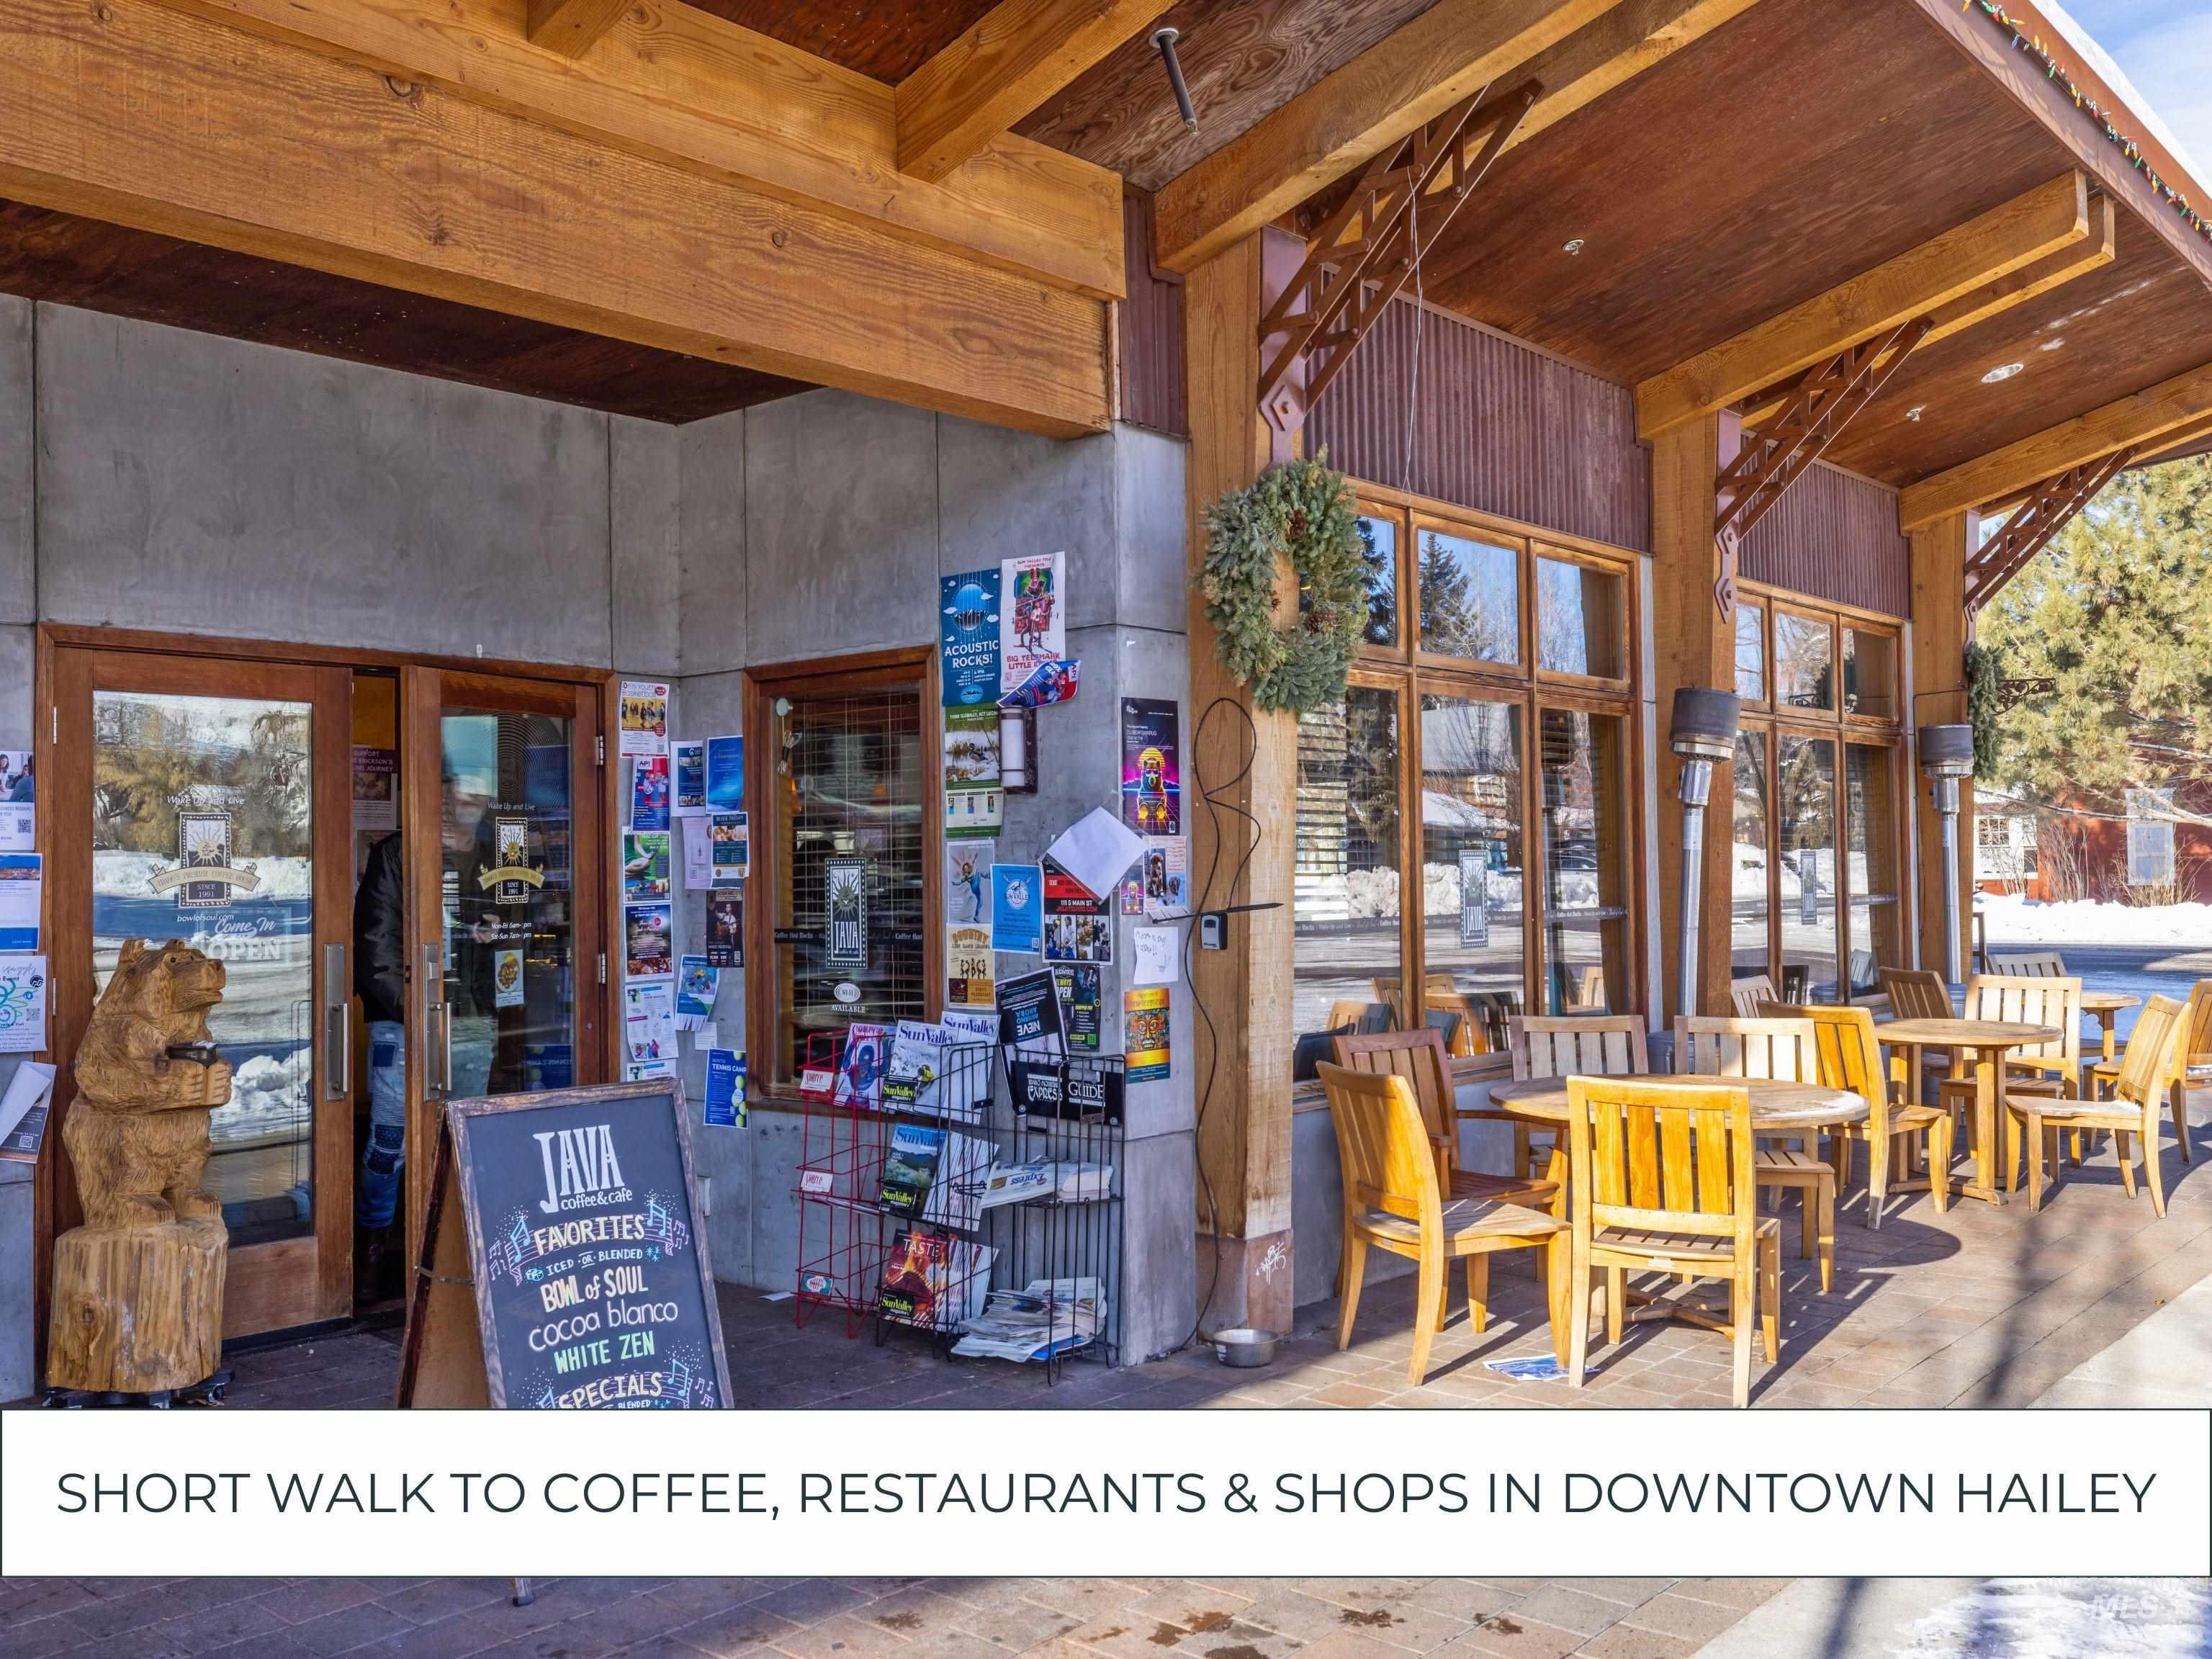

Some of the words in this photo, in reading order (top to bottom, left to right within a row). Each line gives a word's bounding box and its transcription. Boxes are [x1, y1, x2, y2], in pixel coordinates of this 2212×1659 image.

[944, 639, 999, 657] ACOUSTIC
[952, 653, 993, 668] ROCKS!
[167, 795, 191, 805] Wake
[228, 796, 246, 805] Live
[487, 800, 503, 810] Wake
[177, 914, 234, 922] bowlofsoul.com
[215, 919, 257, 936] Come
[256, 917, 276, 932] In
[491, 921, 508, 930] Mon-Fri
[1465, 905, 1483, 936] JAVA
[834, 921, 859, 955] JAVA
[207, 940, 281, 961] OPEN
[831, 1004, 866, 1014] AVAILABLE
[1016, 1020, 1041, 1037] NIEVE
[1027, 1085, 1064, 1102] EXPRESS
[1068, 1082, 1105, 1099] GUIDE
[533, 1124, 626, 1214] JAVA
[1010, 1172, 1045, 1186] Express
[534, 1214, 645, 1256] FAVORITES
[904, 1238, 940, 1257] TASTE
[546, 1259, 575, 1277] ICED
[598, 1248, 643, 1262] BLENDED
[540, 1274, 585, 1313] BOWL
[585, 1274, 601, 1300] of
[603, 1265, 649, 1298] SOUL
[529, 1311, 601, 1352] cocoa
[606, 1298, 679, 1328] blanco
[553, 1339, 611, 1375] WHITE
[619, 1330, 656, 1361] ZEN
[558, 1372, 663, 1409] SPECIALS
[617, 1399, 652, 1409] BLENDED
